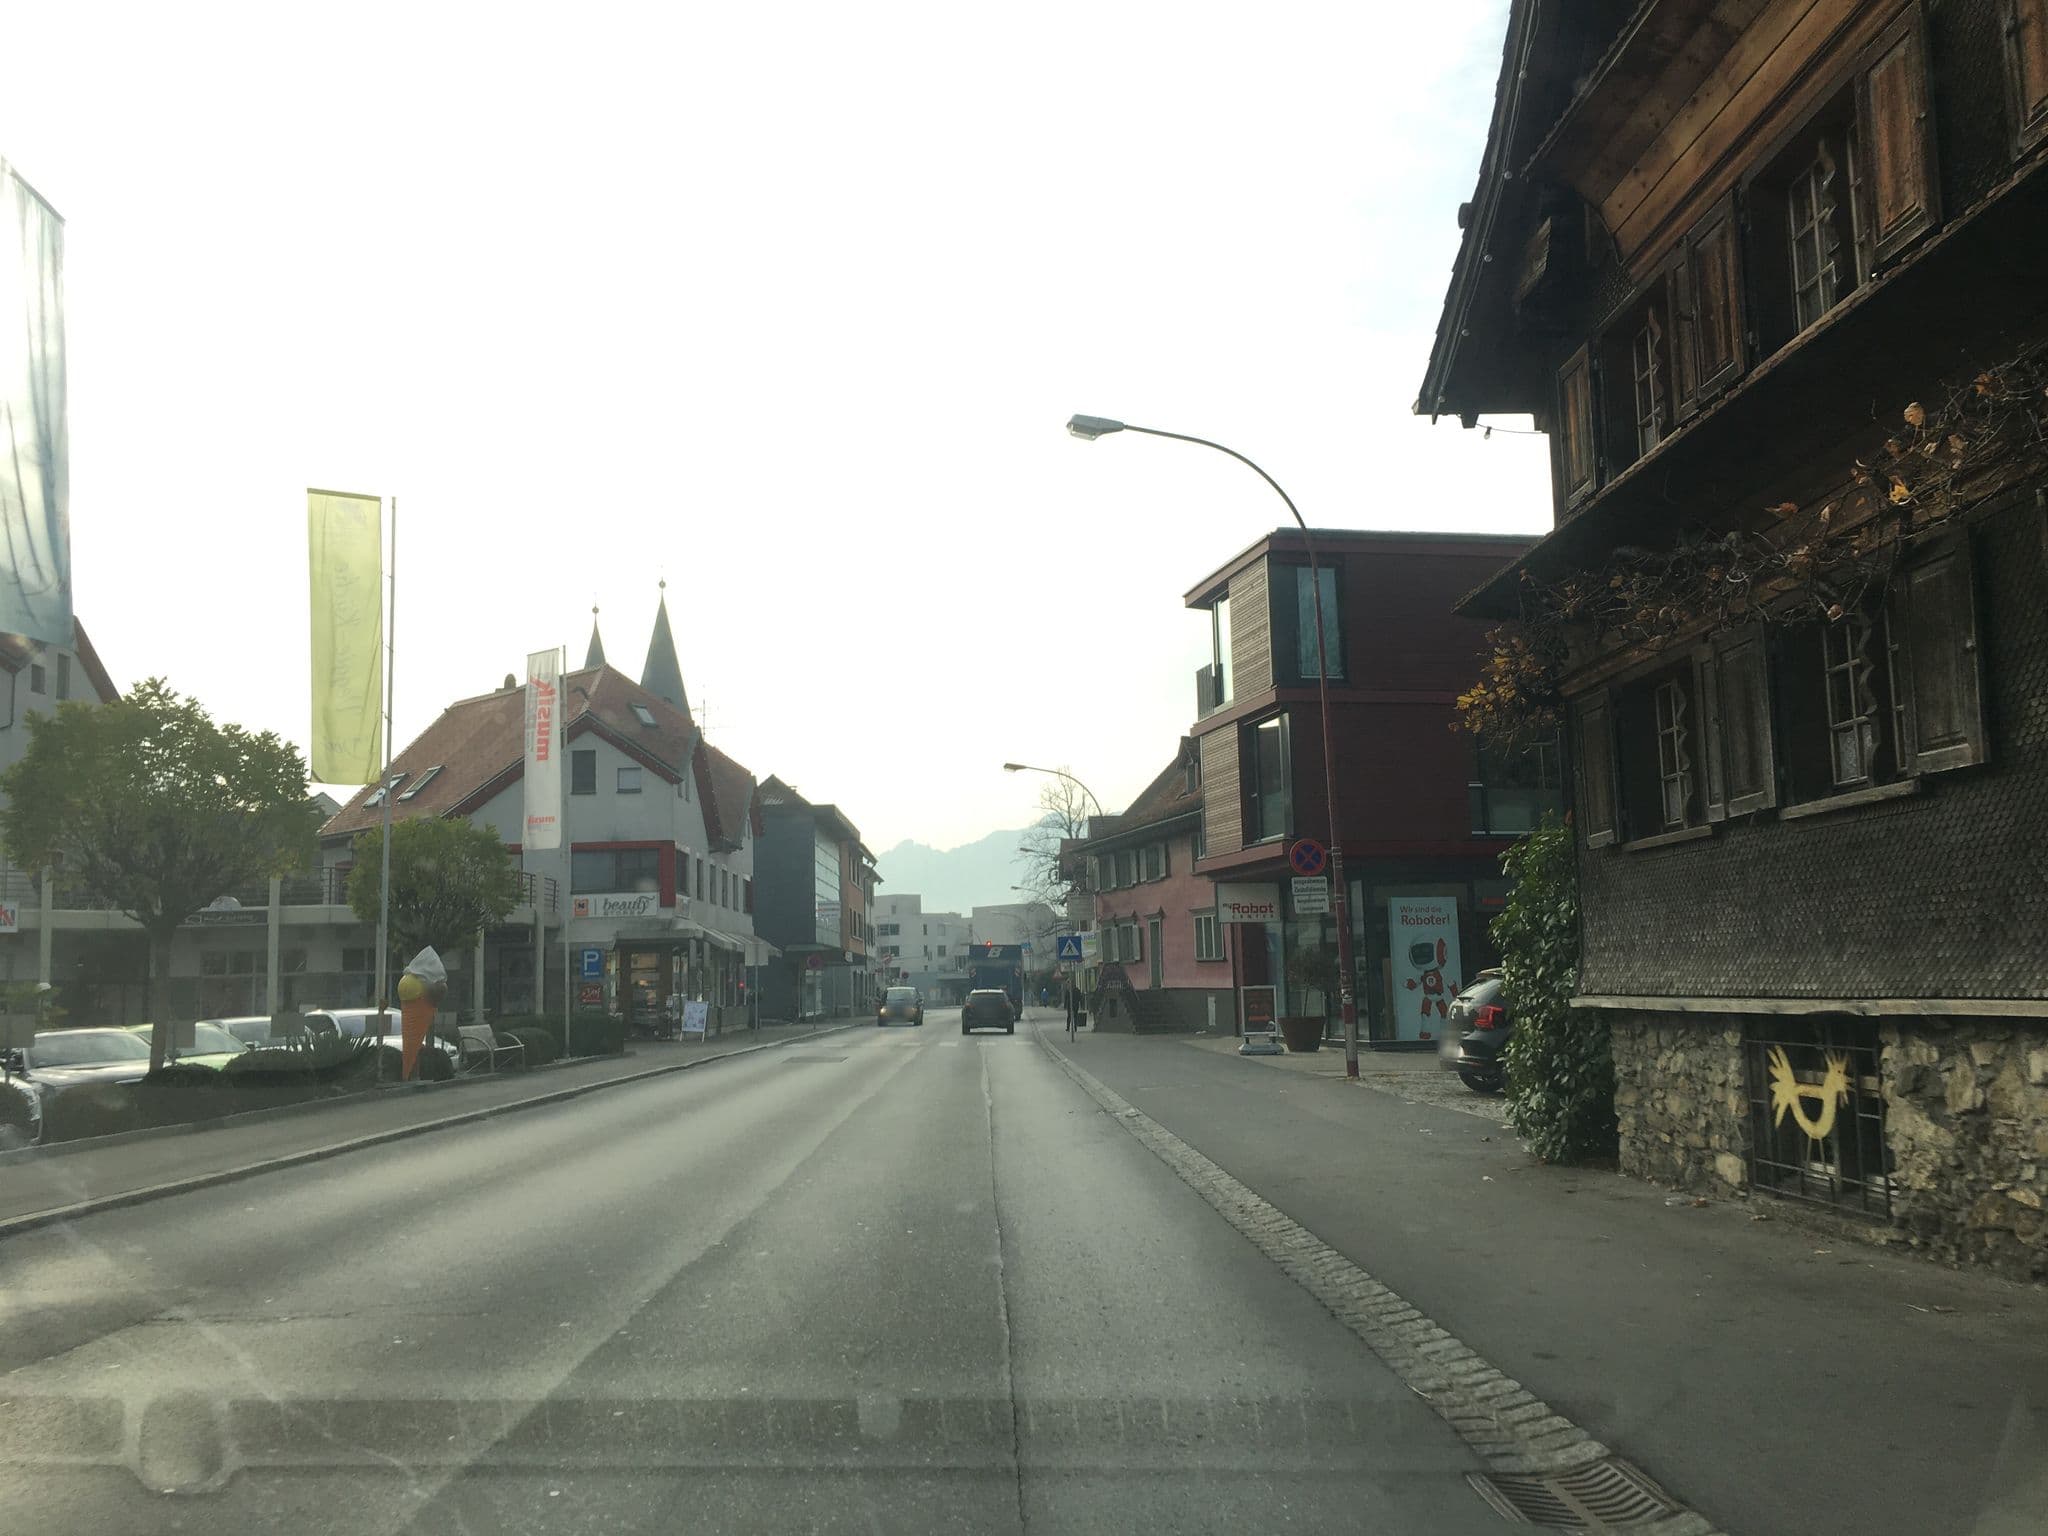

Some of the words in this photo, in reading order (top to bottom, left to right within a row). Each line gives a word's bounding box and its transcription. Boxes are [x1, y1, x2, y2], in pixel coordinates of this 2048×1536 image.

[603, 895, 655, 914] beauty
[1400, 904, 1413, 913] Wir
[1414, 903, 1430, 914] sind
[1401, 914, 1450, 926] Roboter!
[583, 951, 600, 971] P
